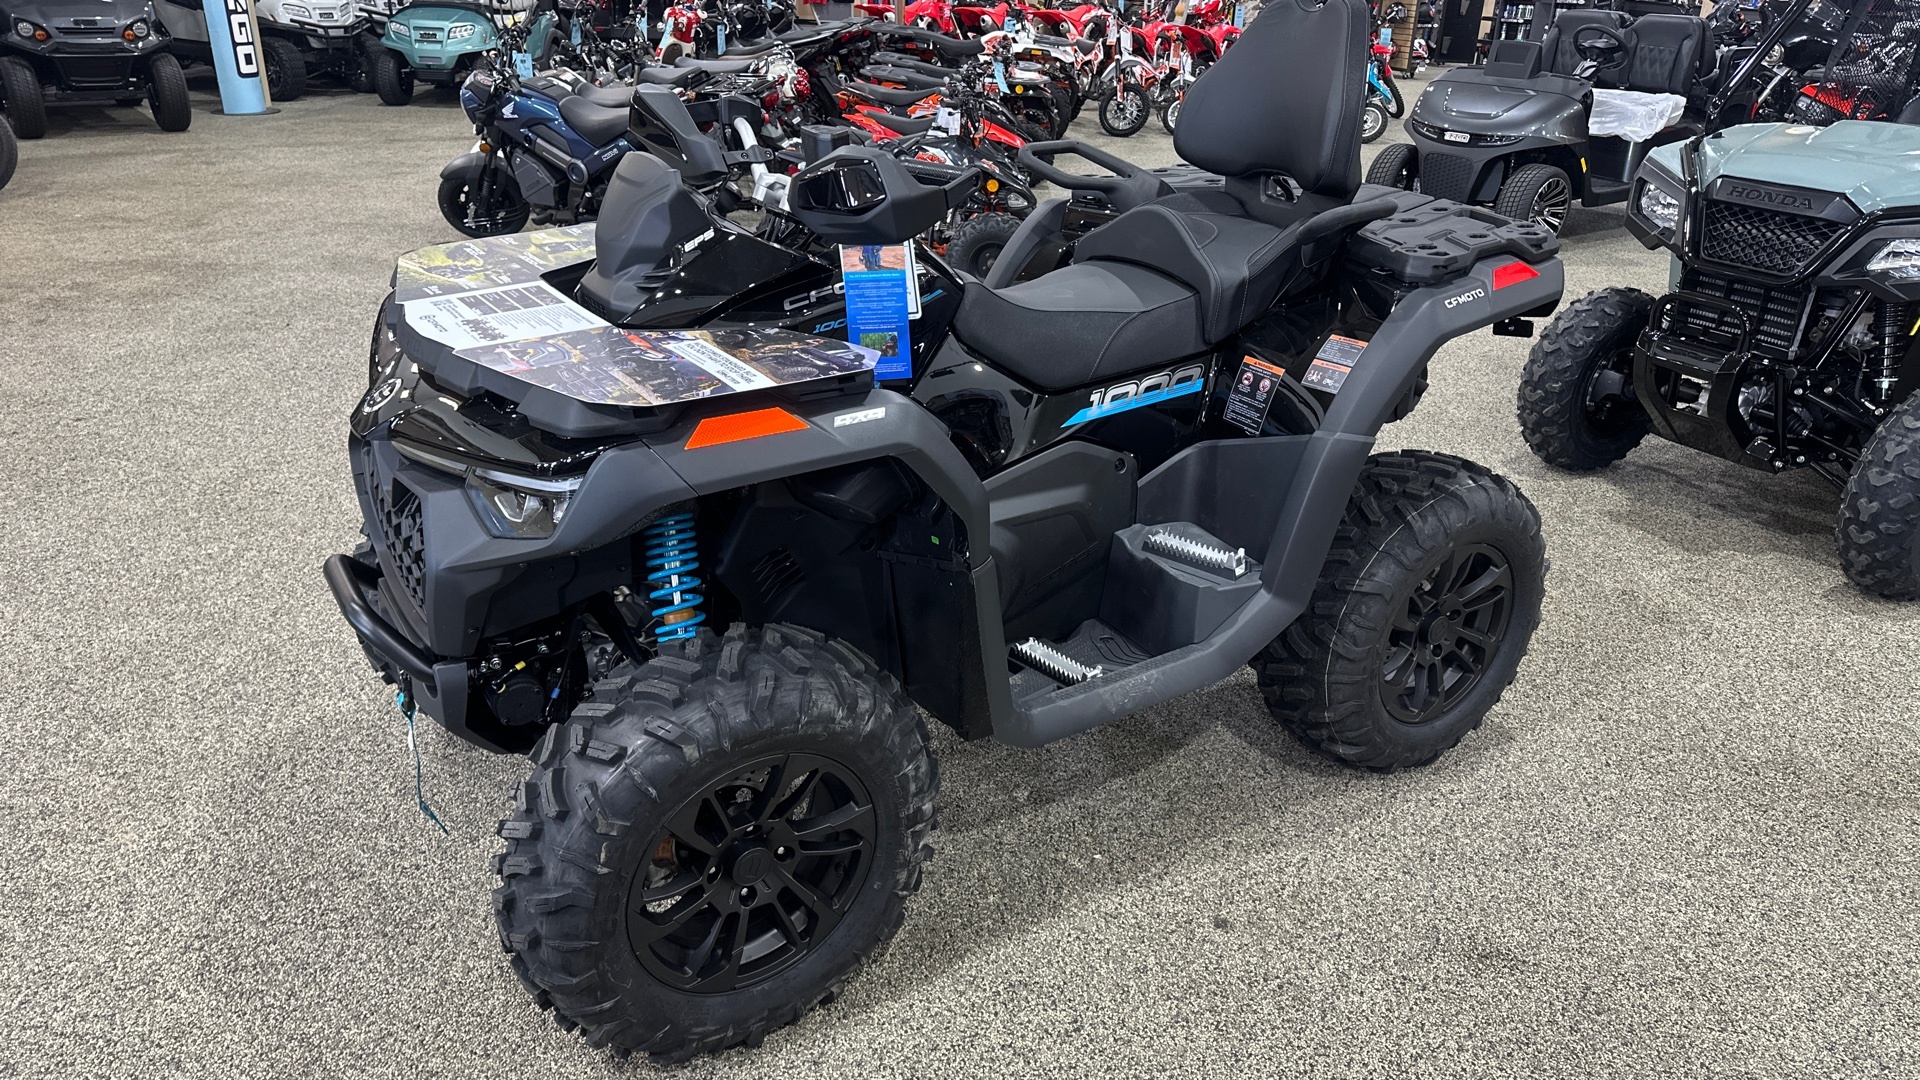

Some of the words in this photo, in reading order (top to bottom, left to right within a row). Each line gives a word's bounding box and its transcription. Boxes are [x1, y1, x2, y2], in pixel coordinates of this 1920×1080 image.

[1726, 185, 1814, 210] HONDA
[684, 228, 715, 253] EPS
[1444, 288, 1485, 309] CFMOTO
[1086, 364, 1204, 417] 1000
